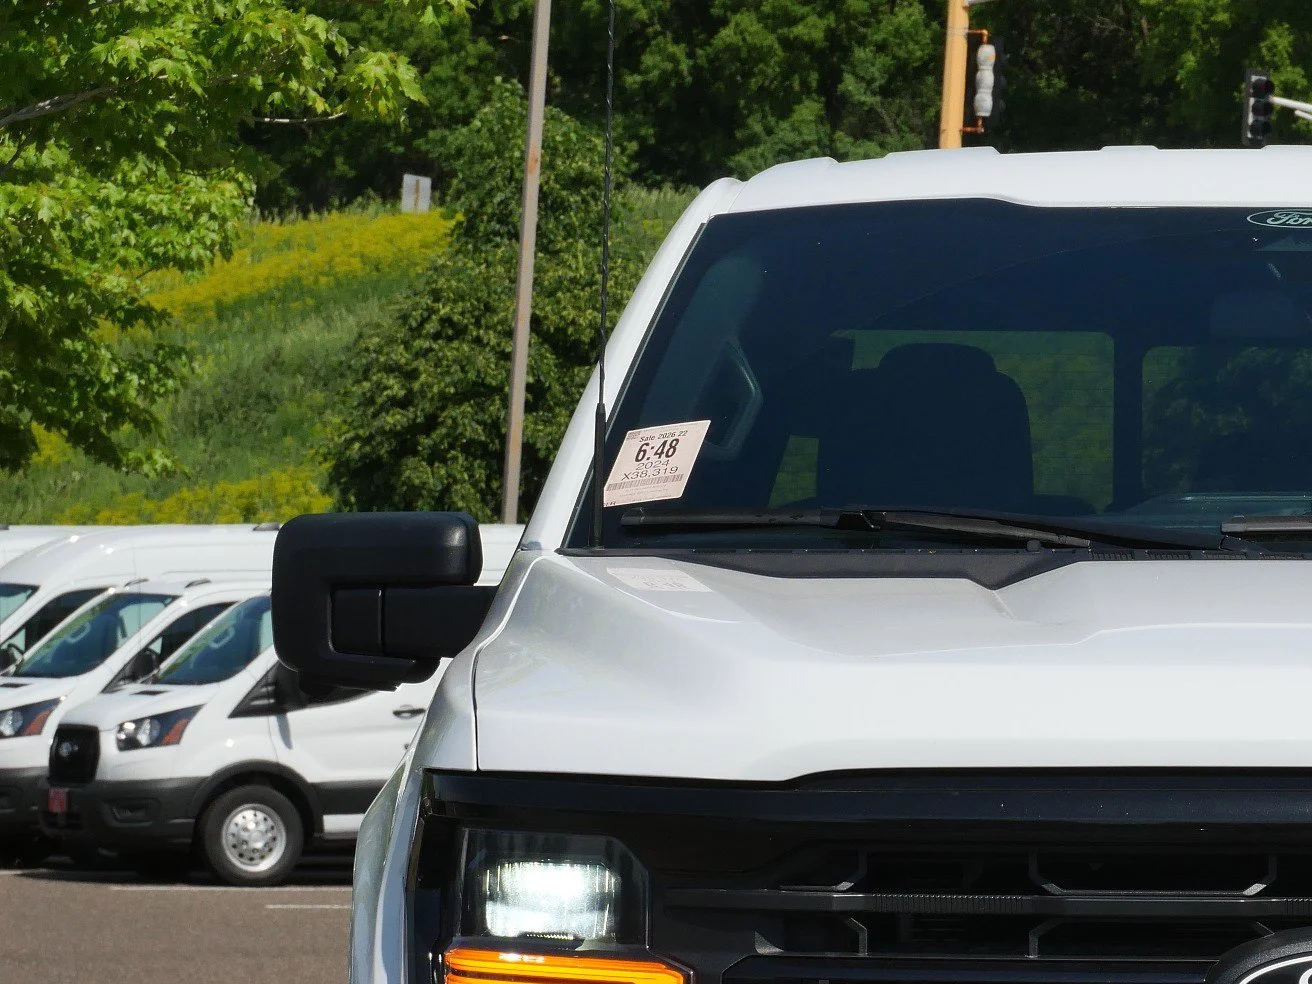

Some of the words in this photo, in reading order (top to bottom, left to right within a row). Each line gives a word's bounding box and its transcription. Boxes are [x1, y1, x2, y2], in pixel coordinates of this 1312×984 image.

[639, 435, 656, 443] Sale
[635, 438, 680, 462] 6:48
[635, 459, 670, 471] 2024
